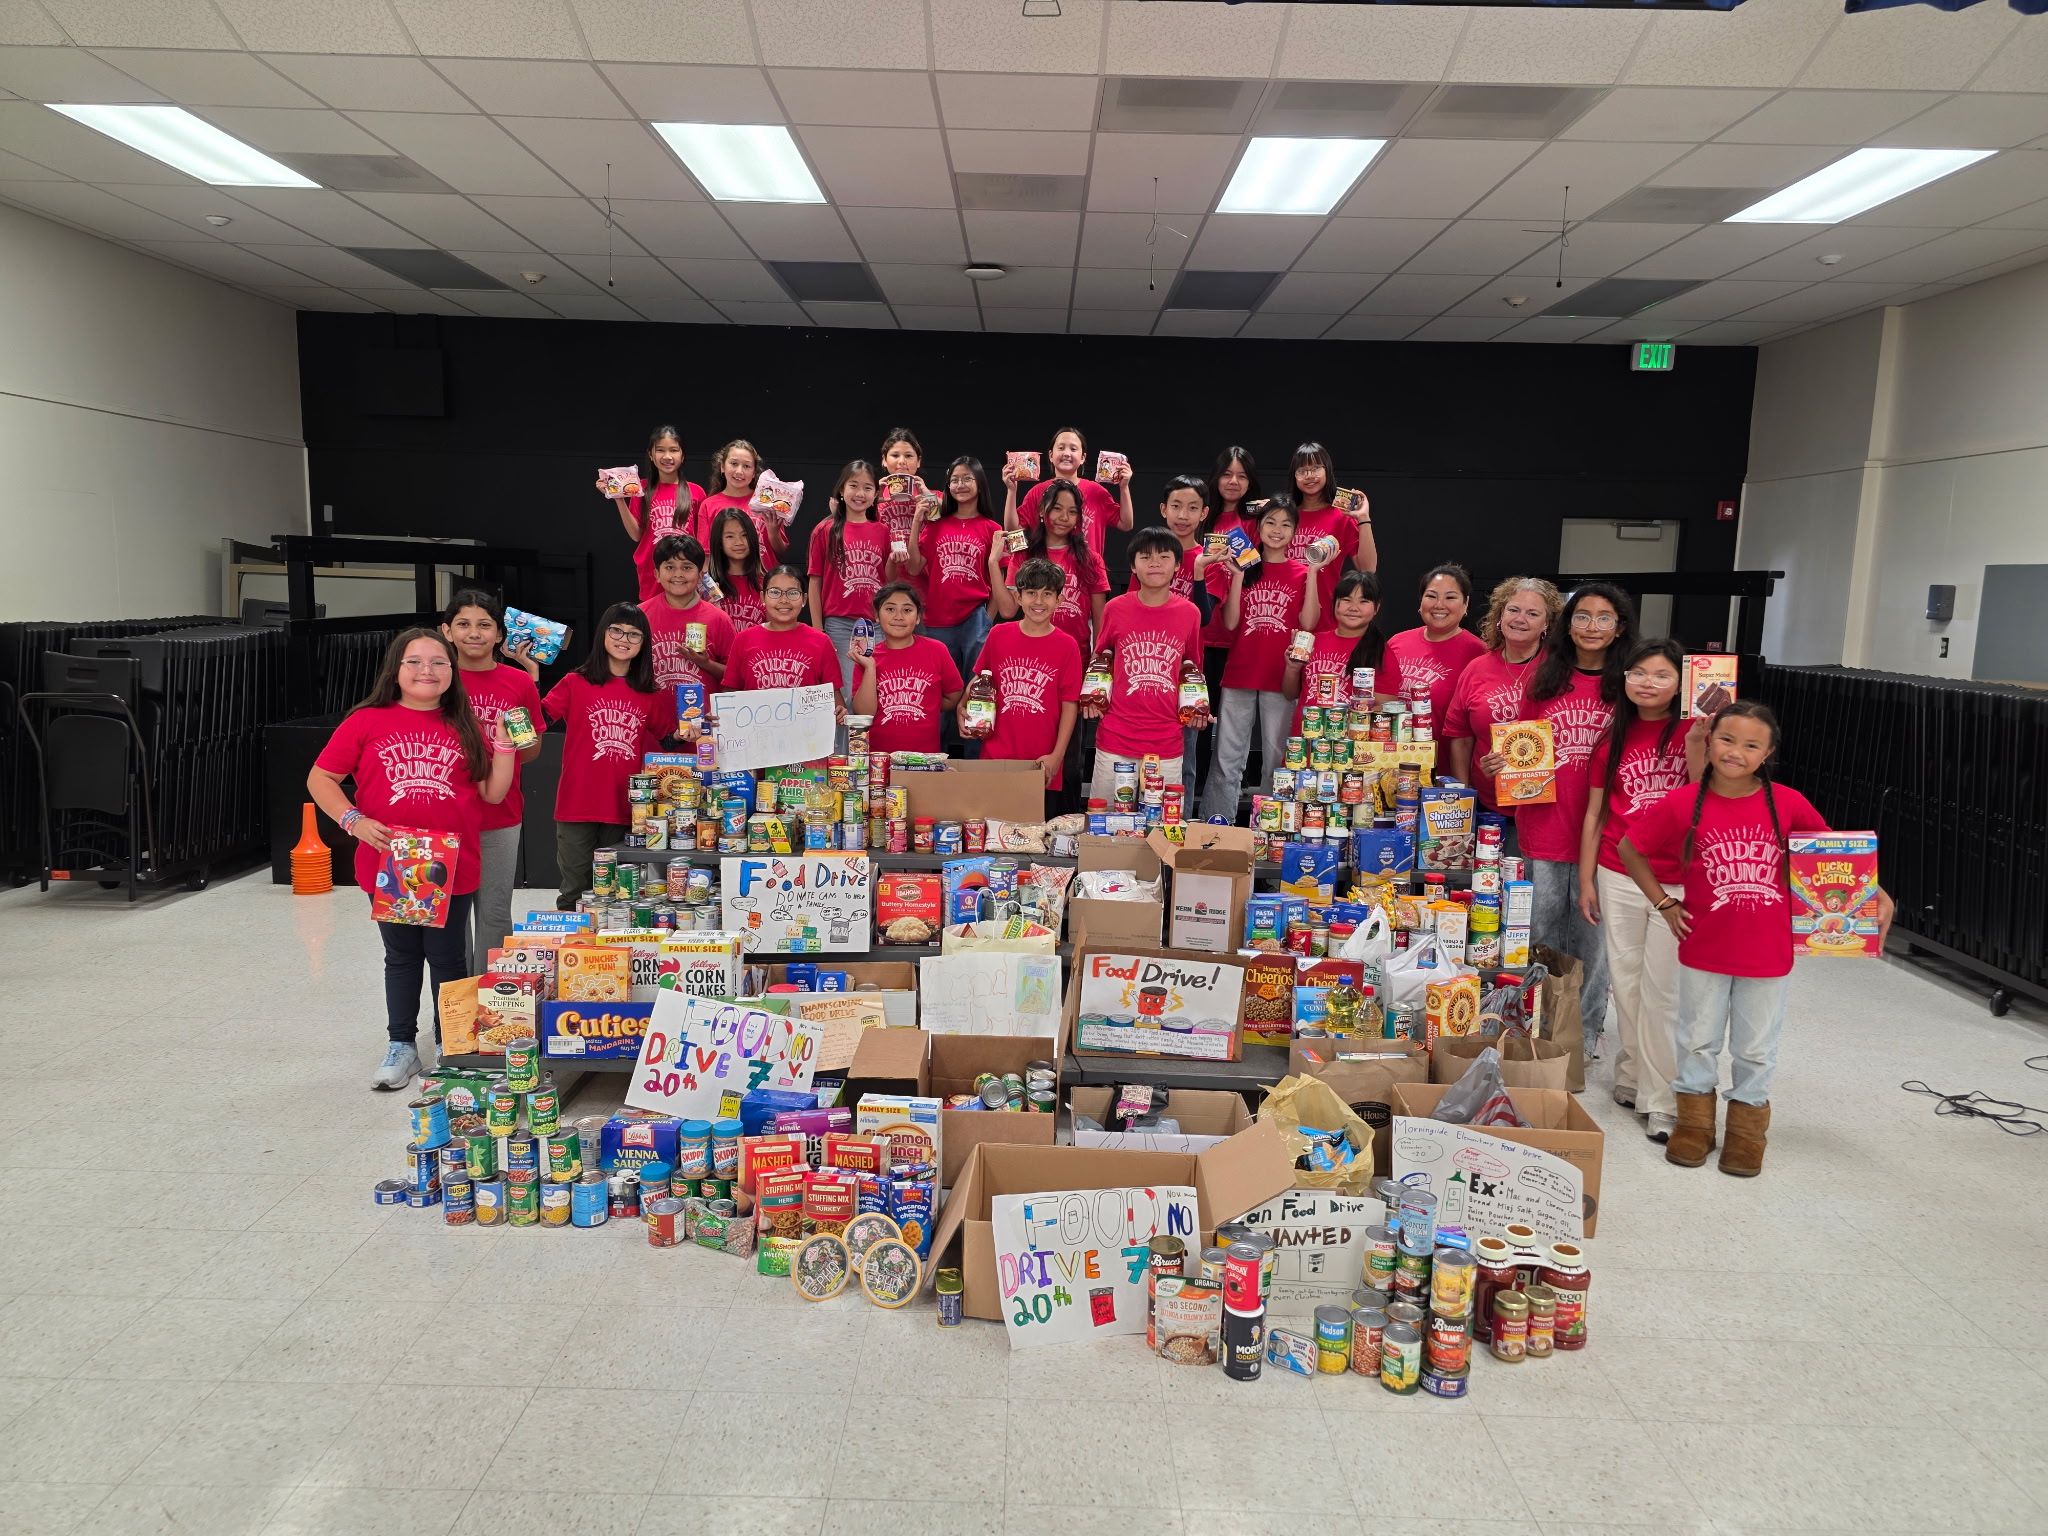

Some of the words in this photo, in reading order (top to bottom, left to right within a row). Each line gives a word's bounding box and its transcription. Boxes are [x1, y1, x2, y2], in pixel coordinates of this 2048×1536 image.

[1639, 344, 1671, 368] EXIT
[937, 541, 981, 559] STUDENT
[939, 554, 977, 572] COUNCIL
[1245, 589, 1293, 608] STUDENT
[1246, 602, 1288, 622] COUNCIL
[1122, 642, 1181, 664] STUDENT
[752, 658, 810, 679] STUDENT
[1000, 665, 1054, 685] STUDENT
[1124, 659, 1175, 680] COUNCIL
[878, 677, 931, 698] STUDENT
[1001, 680, 1045, 702] COUNCIL
[879, 691, 925, 709] COUNCIL
[715, 688, 795, 731] Food
[592, 724, 638, 749] COUNCIL
[717, 734, 746, 752] Drive
[1518, 732, 1542, 753] BUNCHES
[1506, 734, 1518, 755] HONEY
[378, 743, 464, 767] STUDENT
[1517, 755, 1539, 767] OATS
[386, 761, 453, 786] COUNCIL
[1501, 772, 1521, 780] HONEY
[1619, 756, 1687, 782] STUDENT
[394, 780, 422, 790] MORNINGSIDE
[780, 779, 811, 788] APPLE
[1438, 803, 1461, 812] Original
[1429, 810, 1471, 821] Shredded
[771, 822, 778, 830] 4
[1436, 820, 1463, 829] Wheat
[390, 837, 433, 850] FROOT
[1405, 836, 1411, 844] 5
[1815, 840, 1847, 848] FAMILY
[394, 849, 433, 861] LOOPS
[1702, 841, 1783, 867] STUDENT
[1817, 861, 1852, 874] Lucky
[740, 860, 806, 897] Food
[815, 863, 867, 888] Drive
[1707, 863, 1777, 888] COUNCIL
[1812, 872, 1856, 887] Charms
[896, 886, 922, 897] IDAHOAN
[1716, 885, 1746, 895] MORNINGSIDE
[776, 890, 815, 907] DONATE
[818, 892, 837, 900] CANS
[806, 900, 824, 908] FAMILY
[565, 914, 582, 922] SIZE
[584, 955, 618, 964] BUNCHES
[598, 962, 616, 970] FUN!
[632, 959, 660, 973] ORN
[690, 960, 721, 970] Kellogg's
[497, 962, 545, 973] THREE
[1092, 956, 1140, 980] Food
[1141, 964, 1221, 991] Drive!
[1262, 965, 1281, 975] Honey
[685, 970, 725, 984] CORN
[1246, 968, 1294, 985] Cheerios
[686, 984, 726, 996] FLAKES
[800, 999, 864, 1014] THANKSGIVING
[803, 1011, 826, 1021] FOOD
[830, 1008, 856, 1017] DRIVE
[556, 1011, 650, 1039] Cuties
[681, 998, 792, 1062] FOOD
[791, 1033, 814, 1061] NO
[589, 1039, 634, 1051] MANDARINS
[645, 1032, 732, 1079] DRIVE
[746, 1060, 774, 1090] 7
[644, 1069, 698, 1097] 20th
[859, 1105, 884, 1113] FAMILY
[1363, 1110, 1388, 1120] House
[1395, 1119, 1449, 1136] Morningside
[862, 1129, 932, 1146] Cinnamon
[509, 1144, 530, 1152] BUSH'S
[616, 1149, 659, 1160] VIENNA
[682, 1150, 705, 1163] SKIPPY
[714, 1149, 739, 1162] SKIPPY
[752, 1155, 793, 1170] MASHED
[835, 1153, 874, 1169] MASHED
[448, 1185, 470, 1194] BUSH'S
[765, 1184, 795, 1195] STUFFING
[1469, 1172, 1504, 1198] Ex:
[1506, 1187, 1521, 1200] Mac
[1526, 1196, 1541, 1204] and
[808, 1193, 834, 1202] STUFFING
[835, 1195, 849, 1203] MIX
[1468, 1196, 1491, 1207] Bread
[896, 1203, 928, 1212] macaroni
[1281, 1199, 1316, 1221] Food
[1330, 1200, 1364, 1213] Drive
[1023, 1188, 1160, 1251] FOOD
[1168, 1203, 1193, 1235] NO
[1151, 1255, 1181, 1266] Bruce's
[816, 1262, 840, 1290] PHO
[1000, 1250, 1100, 1299] DRIVE
[1121, 1246, 1150, 1284] 7
[1194, 1279, 1220, 1289] ORGANIC
[1013, 1285, 1072, 1326] 20th
[1169, 1301, 1178, 1309] 90
[1180, 1301, 1208, 1311] SECOND
[1320, 1322, 1345, 1335] Hudson
[1431, 1318, 1464, 1332] Bruce's
[1439, 1332, 1460, 1342] YAMS
[1236, 1344, 1262, 1354] MORTO
